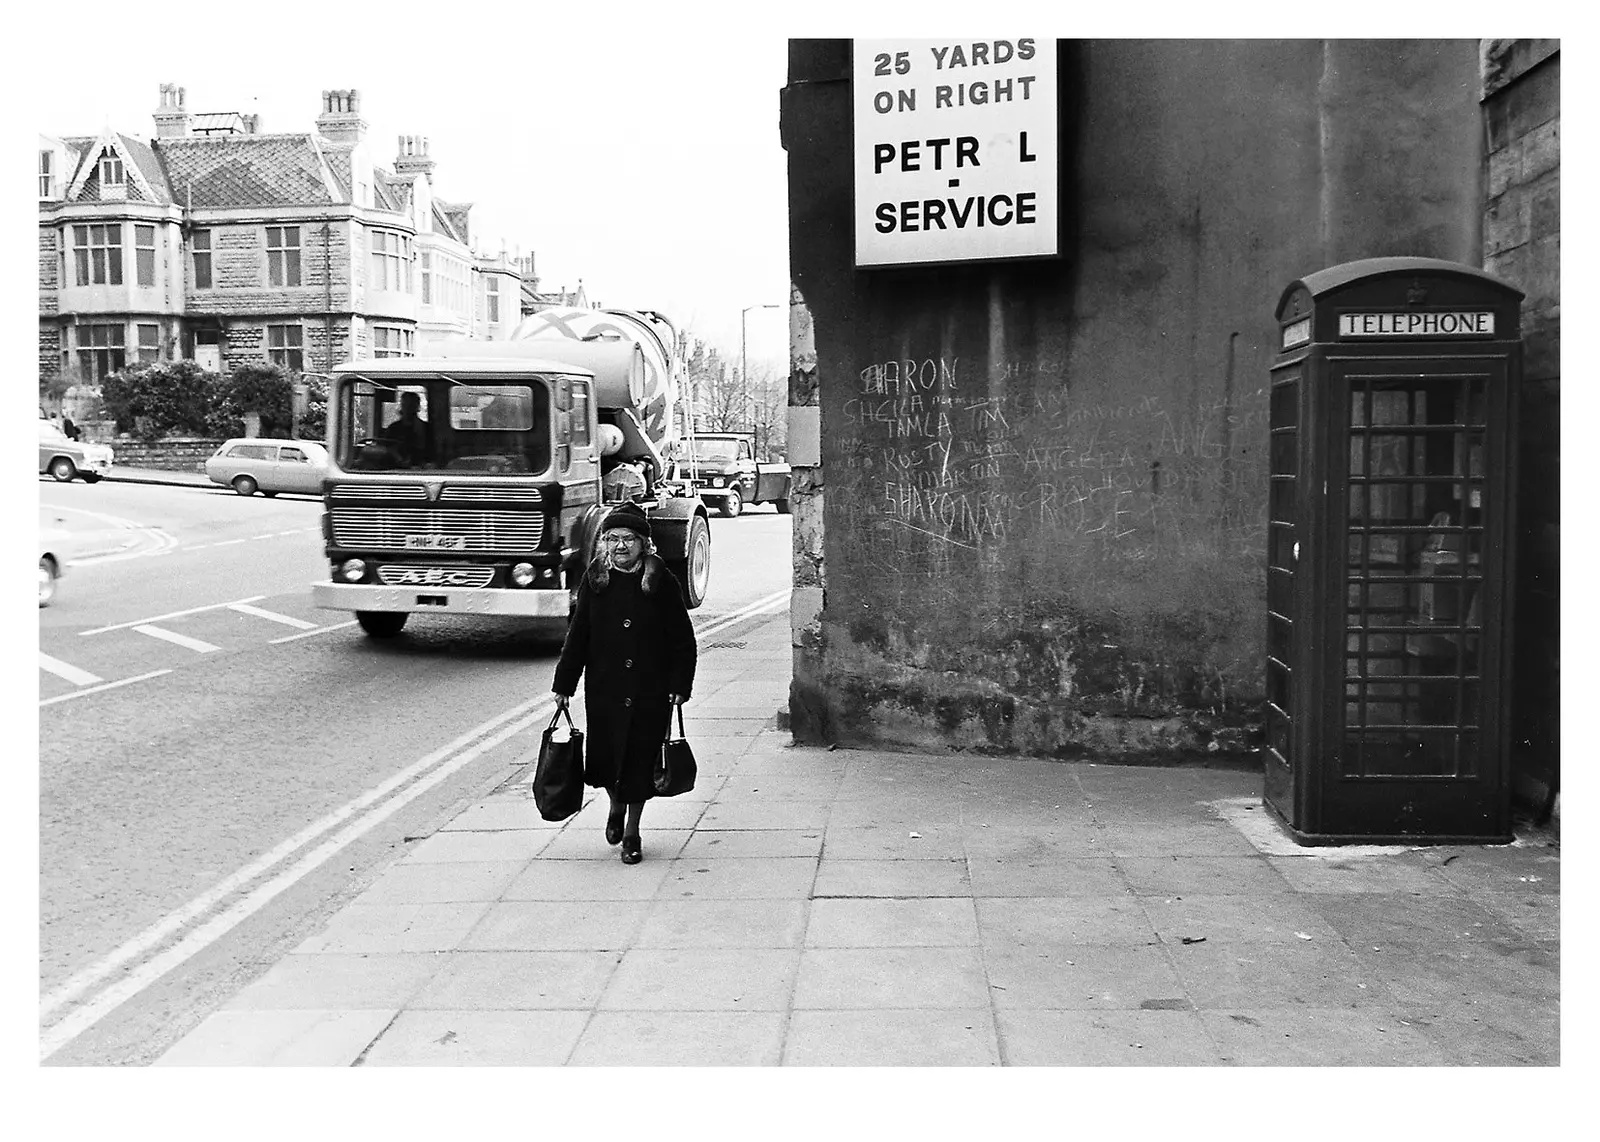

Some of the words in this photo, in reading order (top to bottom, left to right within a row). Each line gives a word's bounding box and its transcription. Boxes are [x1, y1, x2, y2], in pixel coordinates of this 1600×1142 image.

[874, 52, 911, 76] 25
[931, 38, 1036, 69] YARDS
[874, 89, 916, 114] ON
[936, 76, 1036, 109] RIGHT
[874, 131, 1037, 174] PETRL
[875, 192, 1036, 234] SERVICE
[1346, 313, 1489, 333] TELEPHONE
[402, 568, 468, 585] AEC
